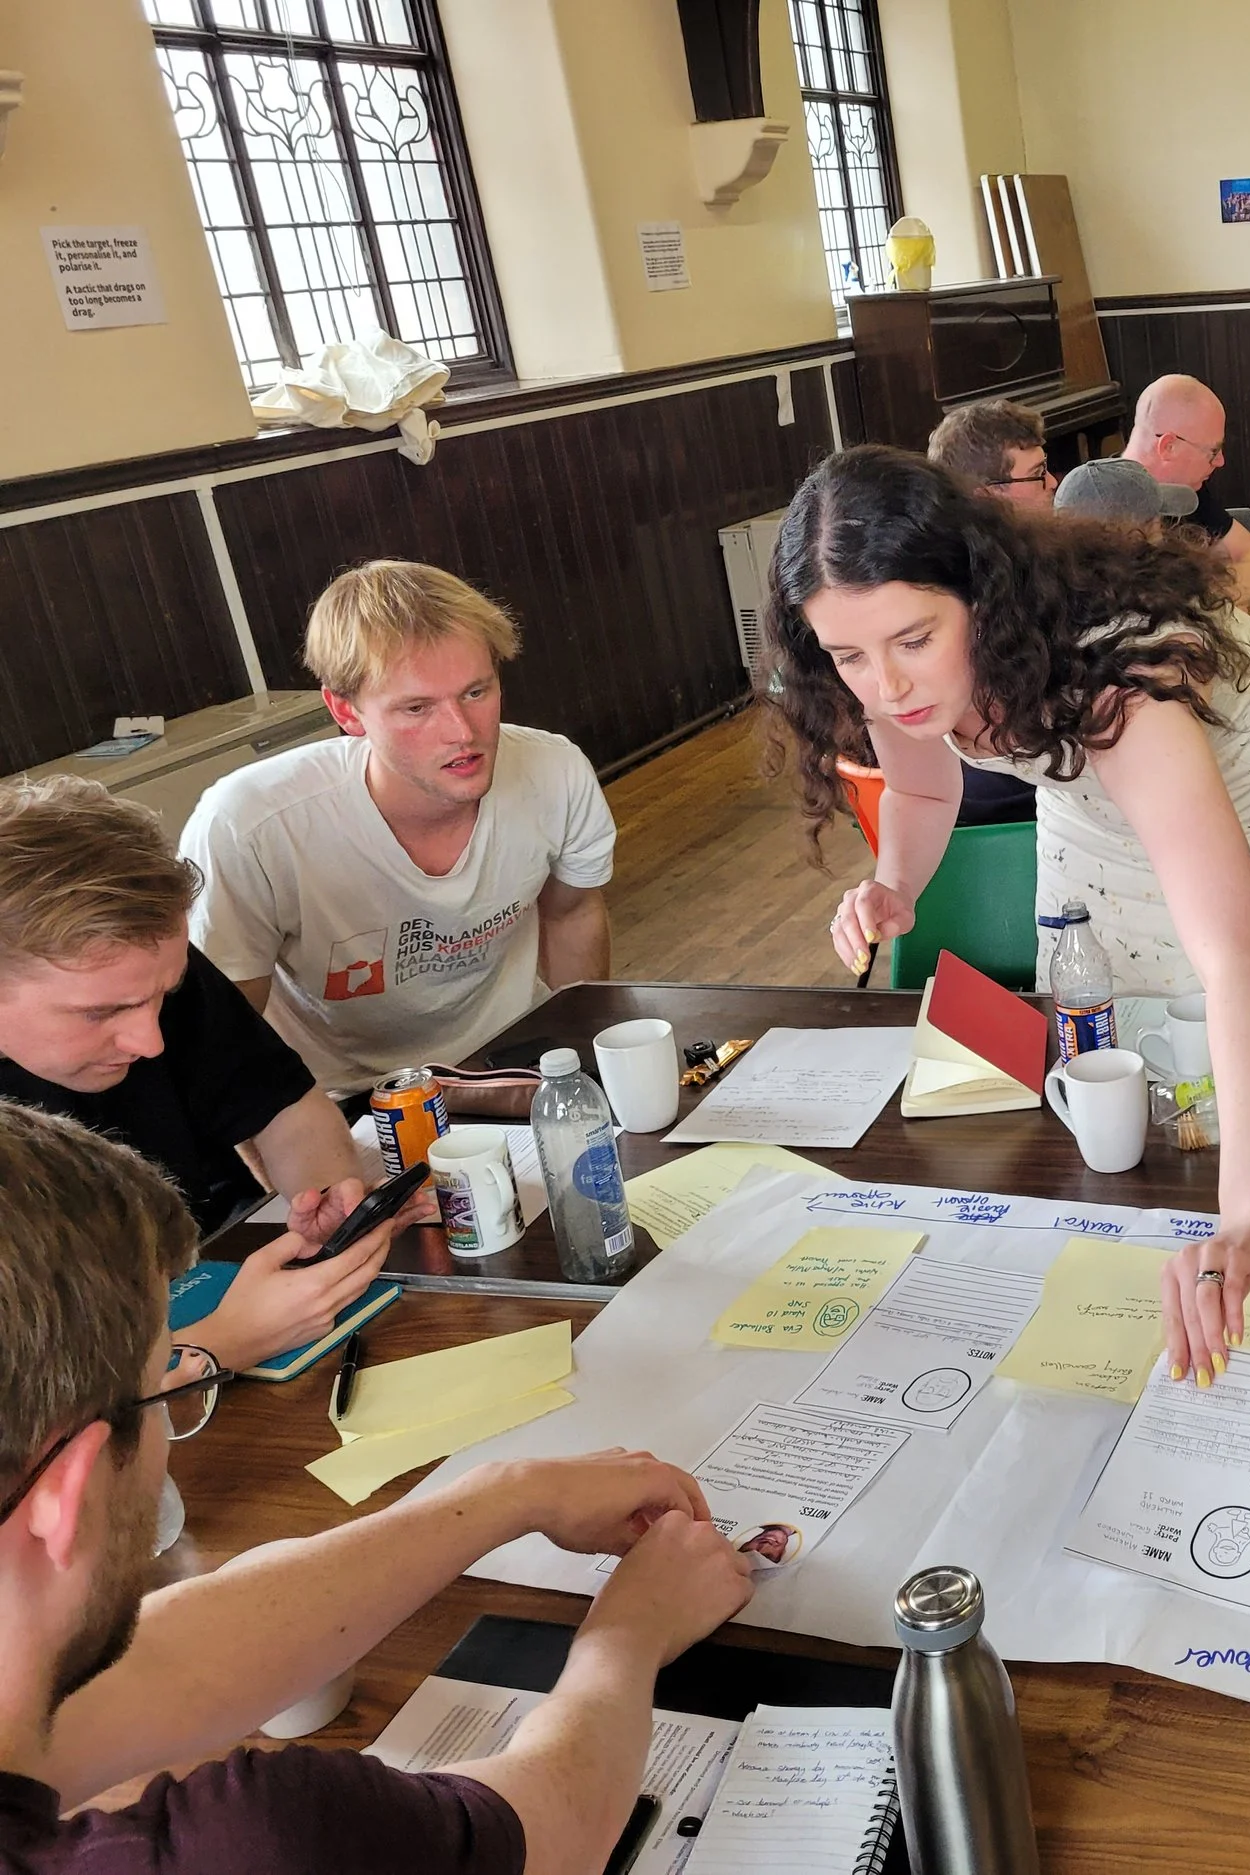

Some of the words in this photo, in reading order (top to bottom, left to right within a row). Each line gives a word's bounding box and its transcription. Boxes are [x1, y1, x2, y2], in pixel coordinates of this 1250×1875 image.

[52, 239, 70, 248] Pick
[72, 239, 85, 248] the
[86, 240, 112, 250] target,
[114, 238, 138, 248] freeze
[56, 253, 66, 262] it,
[68, 251, 111, 262] personalise
[112, 250, 121, 260] it,
[122, 249, 137, 258] and
[59, 262, 92, 273] polarise
[93, 262, 102, 270] it.
[66, 286, 72, 294] A
[74, 285, 95, 294] tactic
[97, 284, 112, 292] that
[114, 283, 134, 293] drags
[69, 298, 84, 306] too
[85, 296, 103, 306] long
[104, 295, 135, 303] becomes
[72, 307, 95, 318] drag.
[399, 900, 521, 946] GRØNLANDSKE
[401, 919, 434, 934] DET
[397, 941, 433, 959] HUS
[395, 942, 490, 971] KALAALLIT
[1065, 1027, 1074, 1057] XTRA
[787, 1300, 811, 1308] SNP
[783, 1324, 803, 1333] Eva
[966, 1348, 996, 1360] NOTES:
[878, 1381, 899, 1389] Ward:
[861, 1395, 886, 1404] NAME:
[799, 1506, 831, 1520] NOTES:
[710, 1516, 738, 1526] Commi
[1157, 1523, 1182, 1536] Ward:
[1153, 1529, 1179, 1543] Party:
[1141, 1544, 1172, 1562] NAME:
